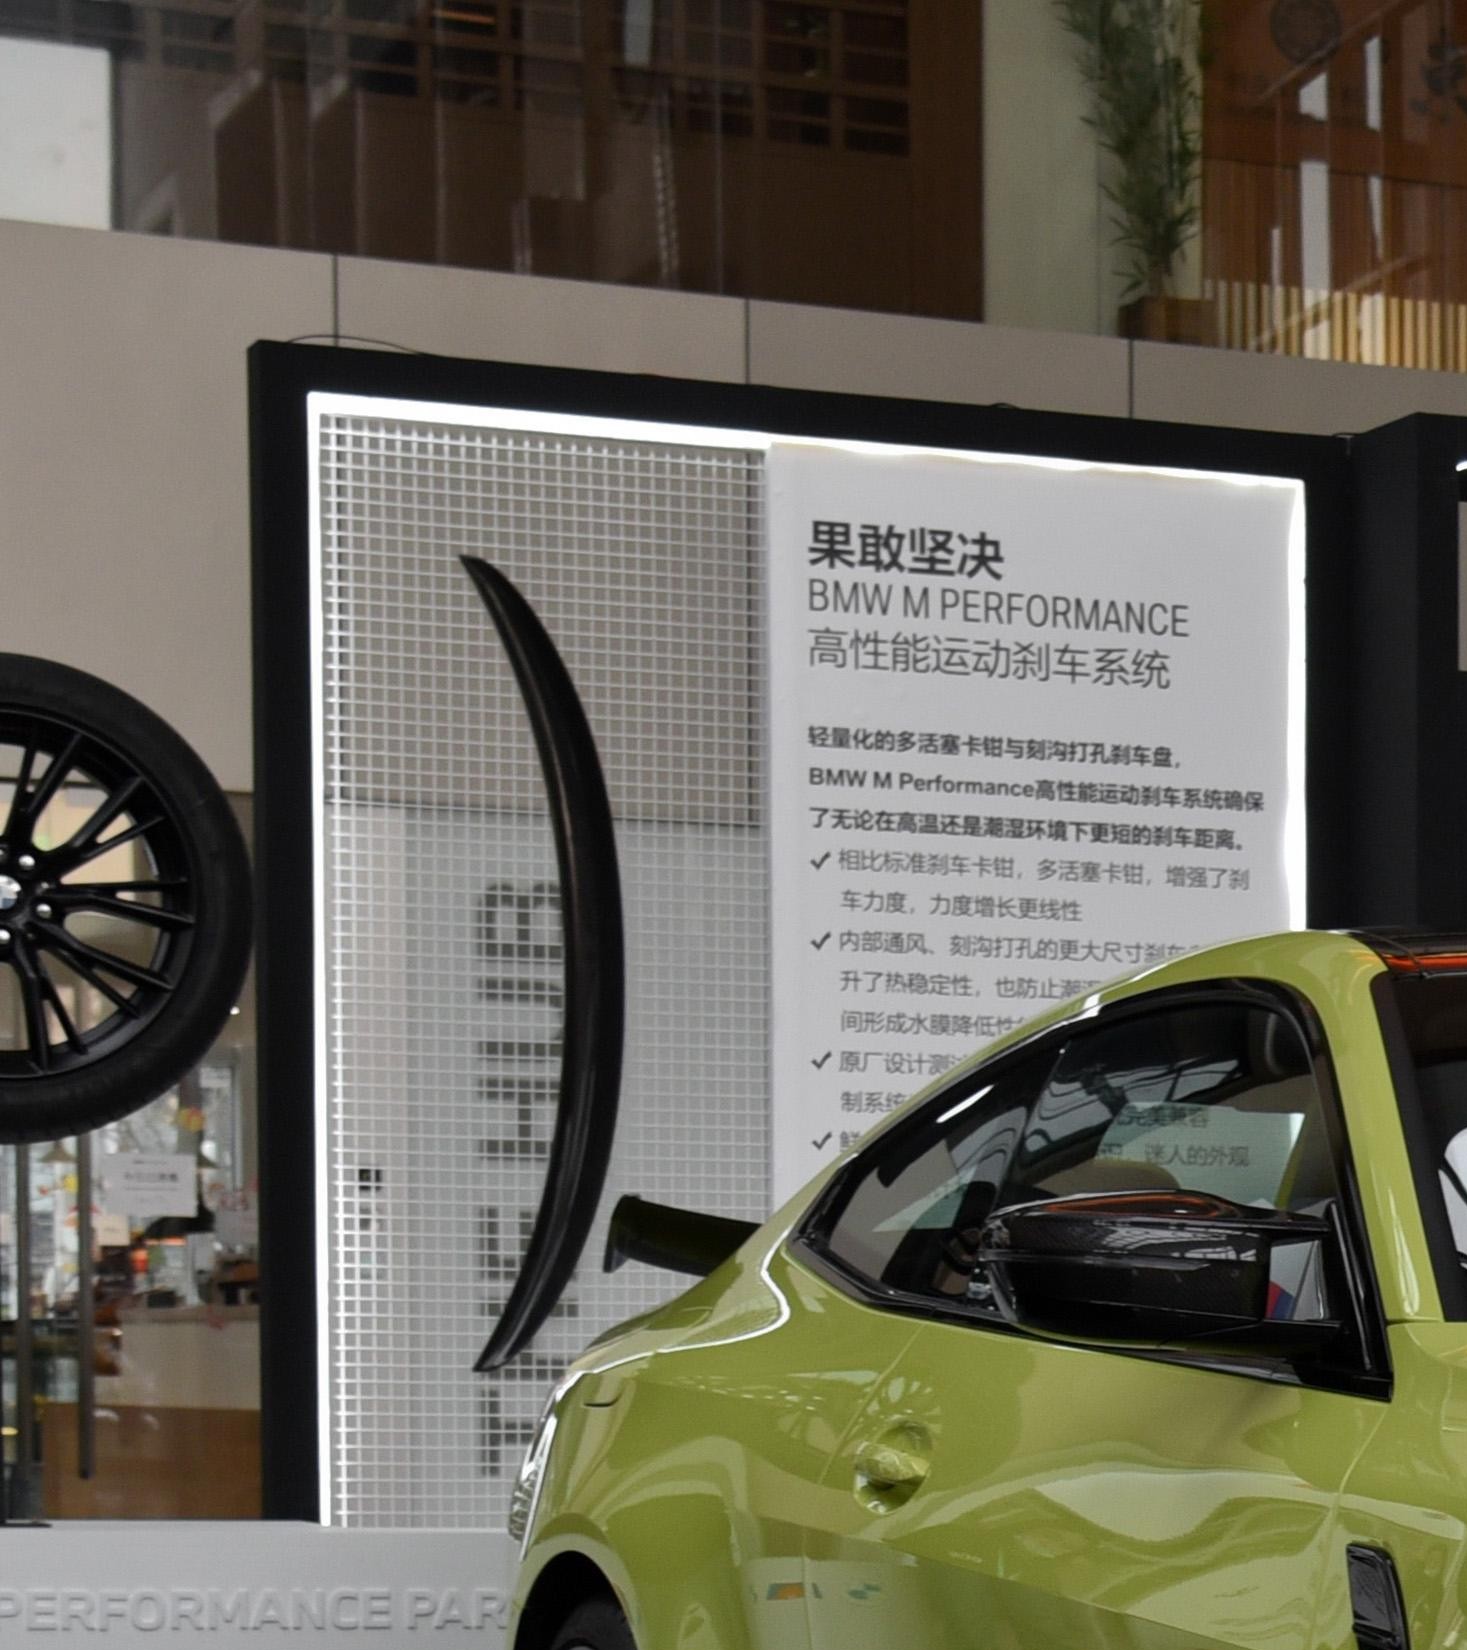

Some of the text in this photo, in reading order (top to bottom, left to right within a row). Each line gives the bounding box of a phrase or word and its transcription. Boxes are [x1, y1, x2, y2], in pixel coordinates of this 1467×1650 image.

[807, 520, 1005, 580] 果敢坚决
[808, 579, 1190, 637] BMW M PERFORMANCE
[807, 626, 1171, 690] 高性能运动刹车系统
[809, 767, 867, 788] BMW
[873, 771, 892, 789] M
[839, 1051, 967, 1075] 原厂设计测
[0, 1587, 393, 1632] PERFORMANCE
